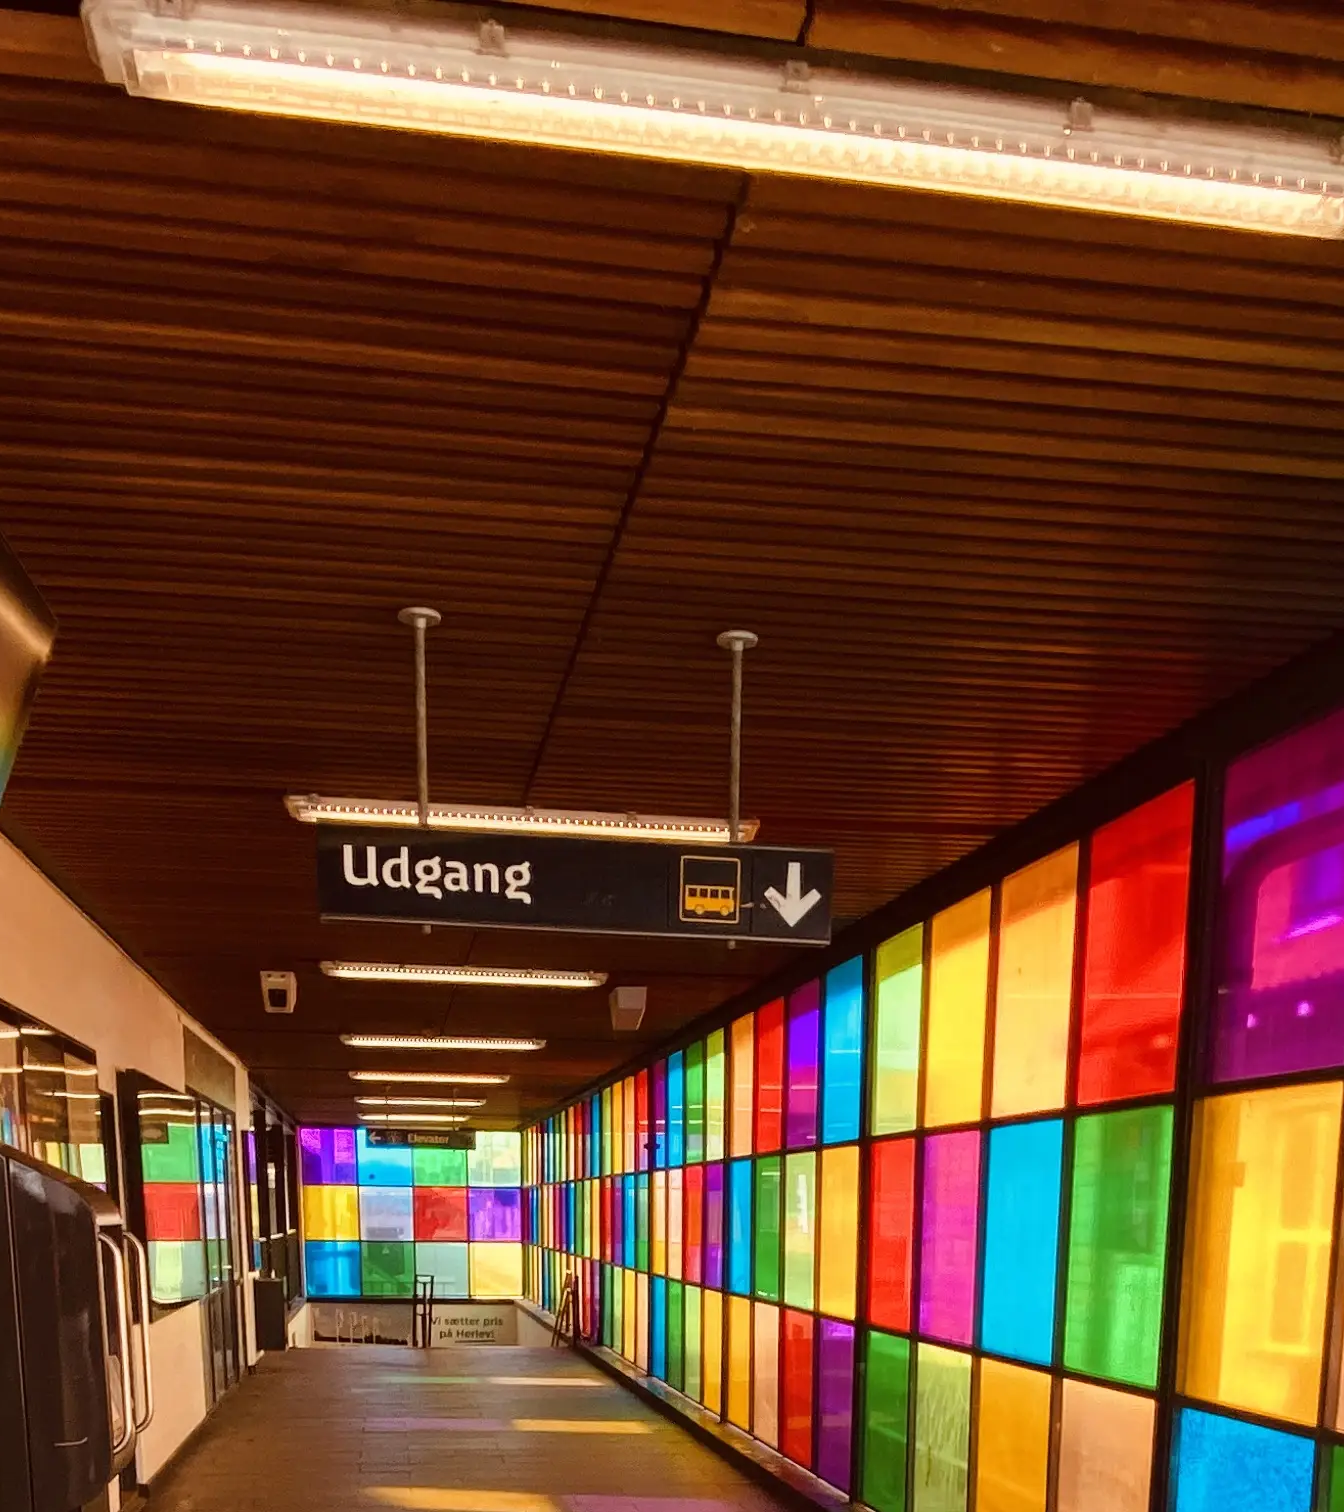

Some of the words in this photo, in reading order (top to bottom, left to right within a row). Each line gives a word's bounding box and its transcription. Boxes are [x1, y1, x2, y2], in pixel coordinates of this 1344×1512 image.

[340, 843, 532, 905] Udgang
[407, 1132, 450, 1145] Elevator
[444, 1317, 481, 1327] sætter
[483, 1316, 504, 1329] pris
[439, 1326, 453, 1340] på
